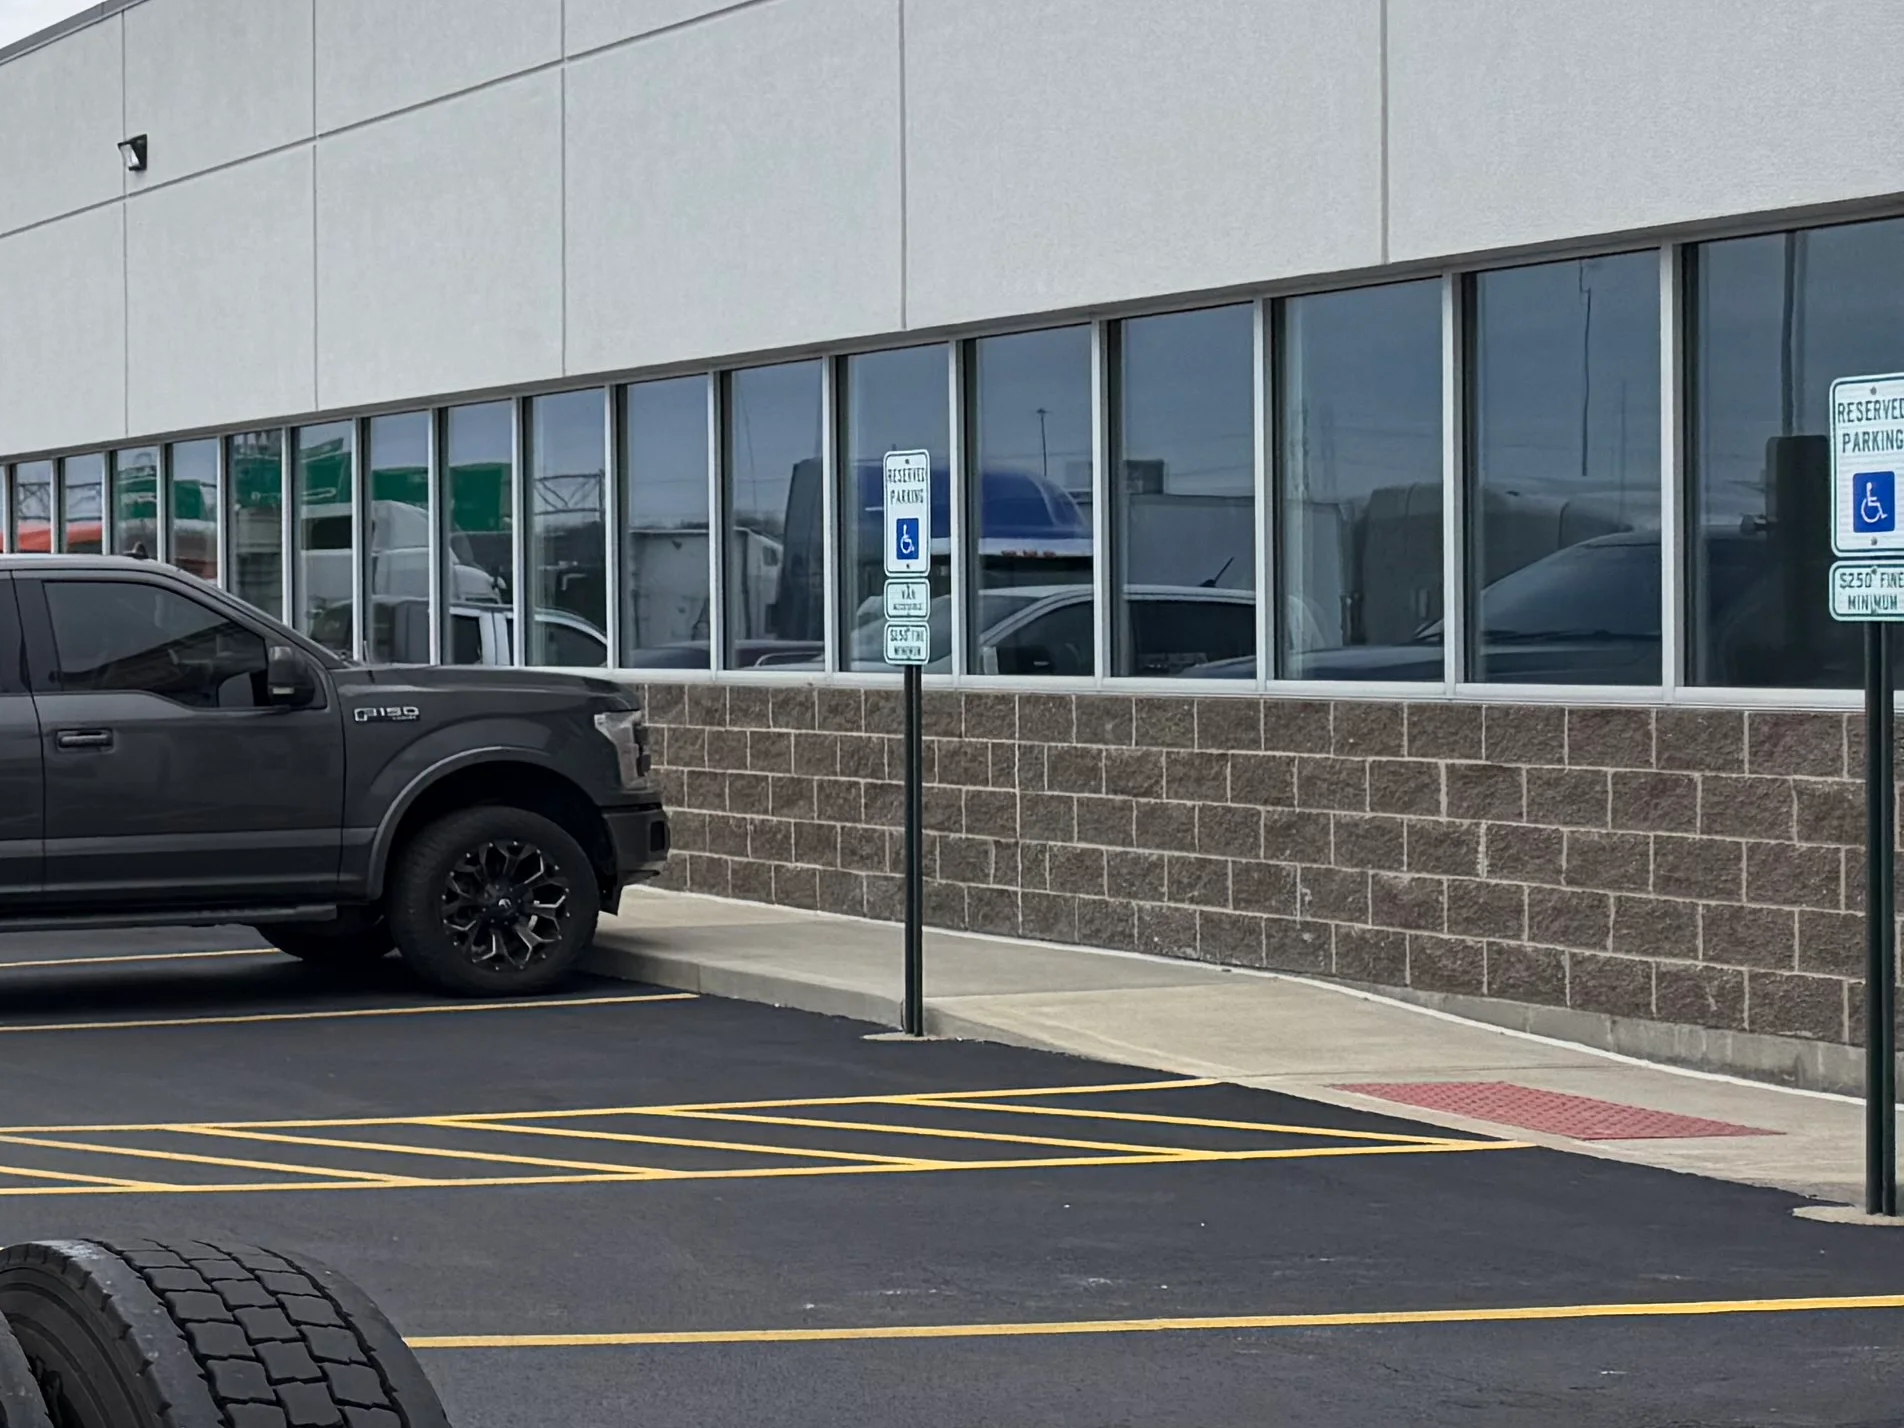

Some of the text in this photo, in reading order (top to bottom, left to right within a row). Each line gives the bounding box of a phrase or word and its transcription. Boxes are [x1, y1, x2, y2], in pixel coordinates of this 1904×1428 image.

[1843, 429, 1904, 453] PARKING
[1839, 571, 1904, 590] $250 FINE
[1847, 594, 1898, 611] MINIMUM
